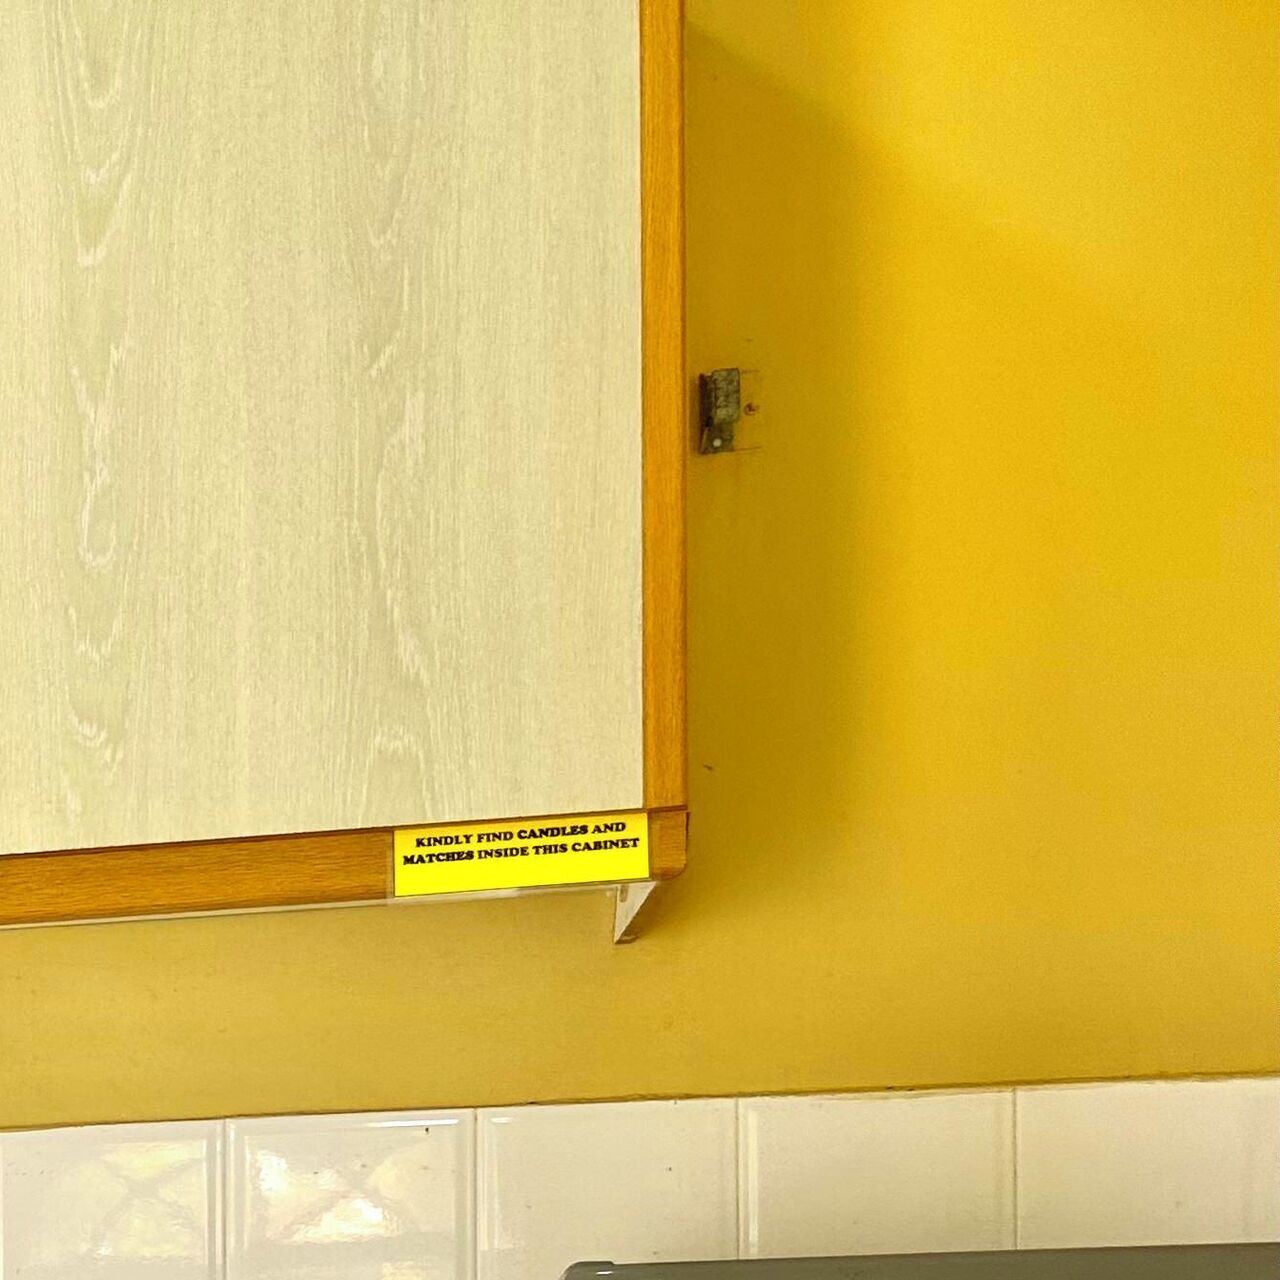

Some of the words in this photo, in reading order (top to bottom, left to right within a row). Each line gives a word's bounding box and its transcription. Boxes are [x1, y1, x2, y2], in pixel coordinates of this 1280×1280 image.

[415, 834, 473, 848] KINDLY
[477, 831, 514, 843] FIND
[517, 824, 589, 840] CANDLES
[591, 822, 626, 834] AND
[403, 850, 474, 865] MATCHES
[477, 846, 529, 859] INSIDE
[532, 844, 568, 855] THIS
[571, 838, 640, 852] CABINET
